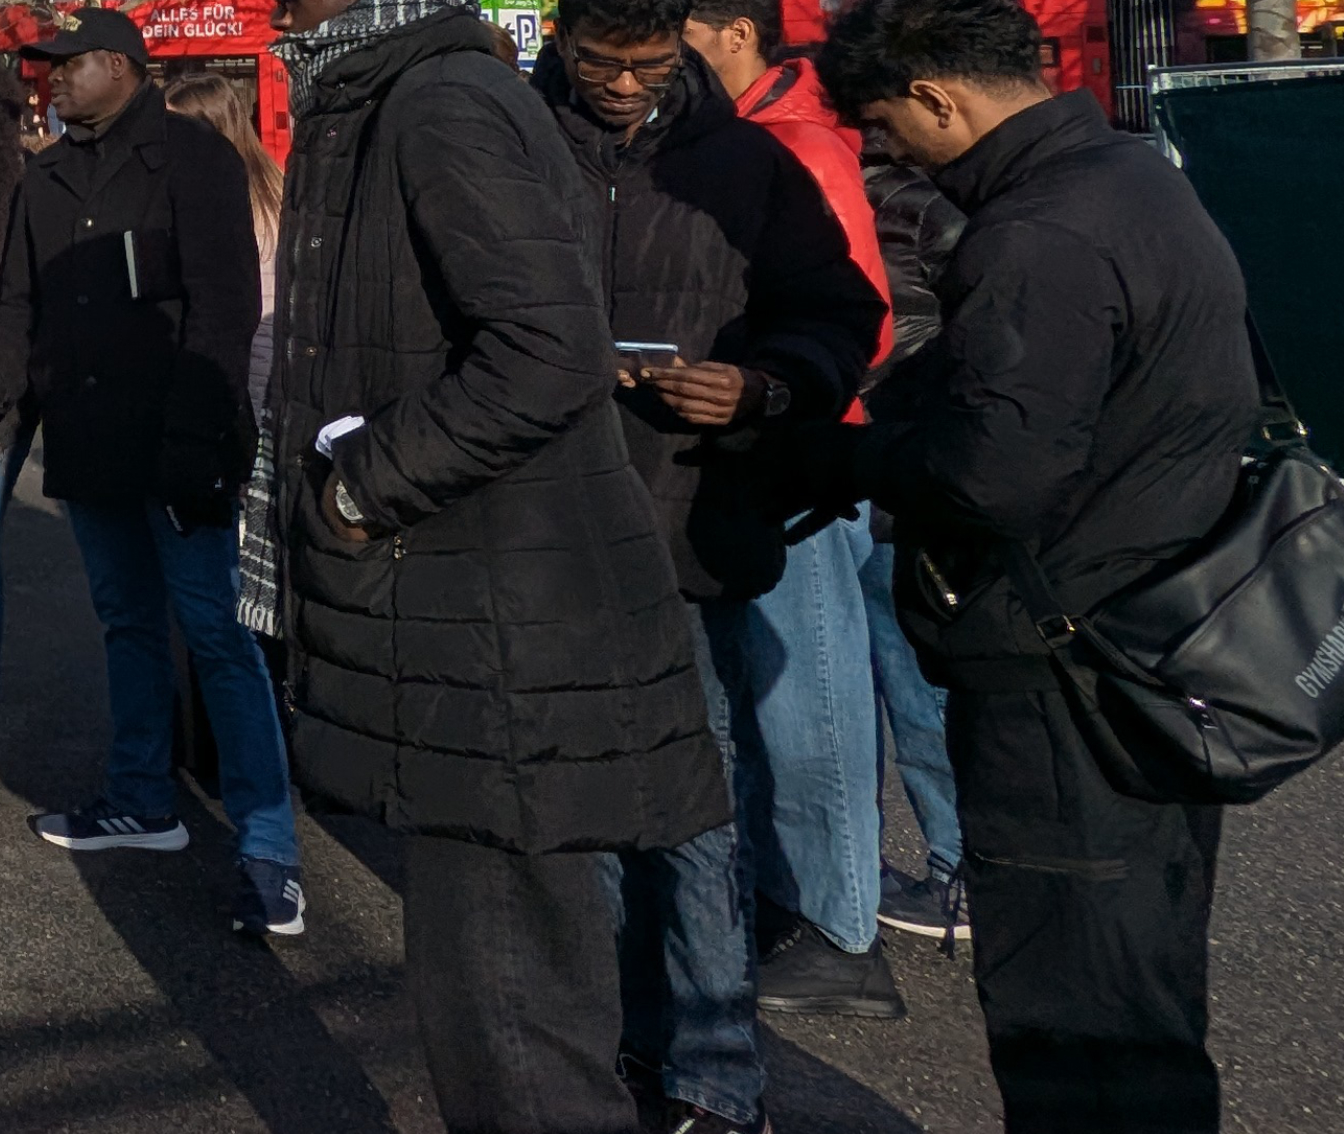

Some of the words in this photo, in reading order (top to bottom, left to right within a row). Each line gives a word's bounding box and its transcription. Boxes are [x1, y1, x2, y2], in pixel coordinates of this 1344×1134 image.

[151, 7, 198, 22] ALLES
[204, 3, 235, 20] FÜR
[142, 23, 179, 38] DEIN
[184, 21, 243, 37] GLÜCK!
[1295, 604, 1344, 699] GYMSHA
